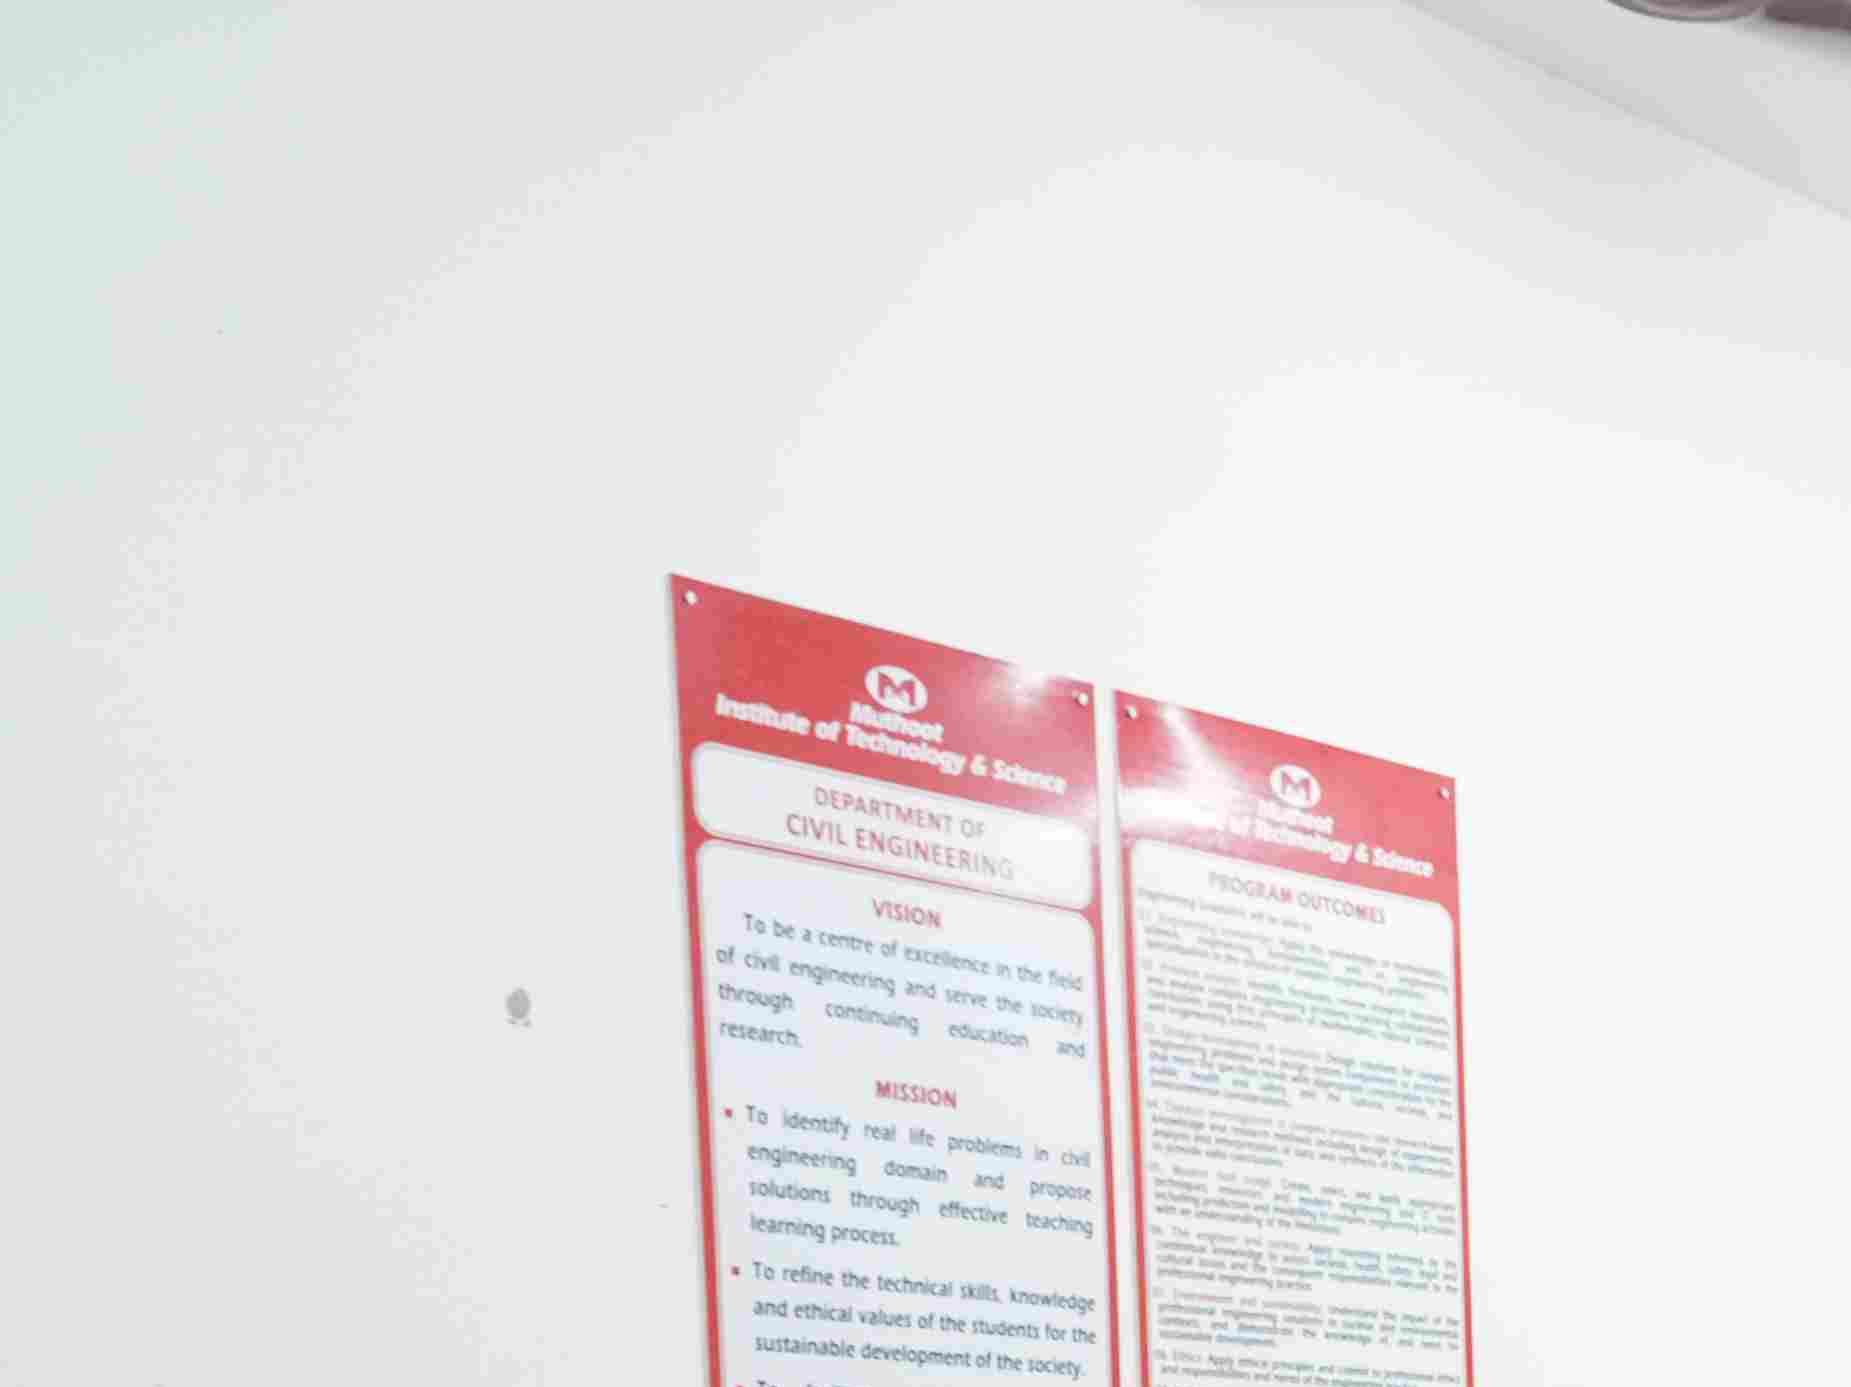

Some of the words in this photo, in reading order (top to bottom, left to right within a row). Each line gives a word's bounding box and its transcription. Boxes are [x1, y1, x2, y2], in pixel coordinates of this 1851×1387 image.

[714, 692, 811, 736] Institute
[814, 715, 841, 743] of
[846, 723, 966, 777] Technology
[991, 759, 1066, 795] Science
[813, 786, 952, 831] DEPARTMENT
[959, 818, 983, 838] OF
[784, 813, 847, 846] CIVIL
[855, 828, 1012, 878] ENGINEERING
[871, 898, 942, 927] VISION
[1209, 871, 1292, 905] PROGRAM
[1297, 890, 1385, 924] OUTCOMES
[742, 912, 766, 934] To
[772, 918, 795, 940] be
[800, 928, 813, 943] a
[816, 930, 875, 954] centre
[879, 939, 898, 957] of
[903, 946, 990, 974] excellence
[995, 962, 1011, 979] in
[1016, 964, 1042, 983] the
[1047, 969, 1082, 991] field
[715, 945, 734, 965] of
[743, 951, 780, 972] civil
[788, 961, 896, 997] engineering
[904, 980, 937, 999] and
[944, 988, 988, 1008] serve
[992, 995, 1023, 1013] the
[1030, 1003, 1083, 1029] society
[717, 982, 794, 1013] through
[824, 1003, 919, 1035] continuing
[946, 1023, 1029, 1047] education
[1056, 1041, 1085, 1058] and
[875, 1080, 957, 1108] MISSION
[744, 1104, 768, 1125] To
[781, 1109, 851, 1140] identify
[863, 1124, 896, 1141] real
[908, 1127, 935, 1147] life
[947, 1136, 1022, 1158] problems
[1033, 1144, 1049, 1161] in
[1060, 1149, 1090, 1167] civil
[746, 1145, 856, 1176] engineering
[883, 1160, 948, 1182] domain
[972, 1173, 1005, 1190] and
[1029, 1180, 1092, 1202] propose
[748, 1179, 831, 1203] solutions
[849, 1190, 919, 1217] through
[938, 1200, 1007, 1223] effective
[1024, 1212, 1093, 1238] teaching
[749, 1212, 826, 1243] learning
[751, 1259, 775, 1280] To
[781, 1265, 834, 1286] refine
[840, 1270, 871, 1289] the
[876, 1275, 952, 1297] technical
[1009, 1288, 1095, 1314] knowledge
[752, 1300, 788, 1318] and
[792, 1303, 853, 1322] ethical
[856, 1308, 911, 1327] values
[917, 1312, 935, 1329] of
[938, 1313, 968, 1333] the
[971, 1319, 1040, 1339] students
[1044, 1322, 1066, 1341] for
[1071, 1327, 1096, 1344] the
[755, 1336, 855, 1357] sustainable
[859, 1343, 971, 1367] development
[974, 1351, 991, 1368] of
[996, 1353, 1023, 1372] the
